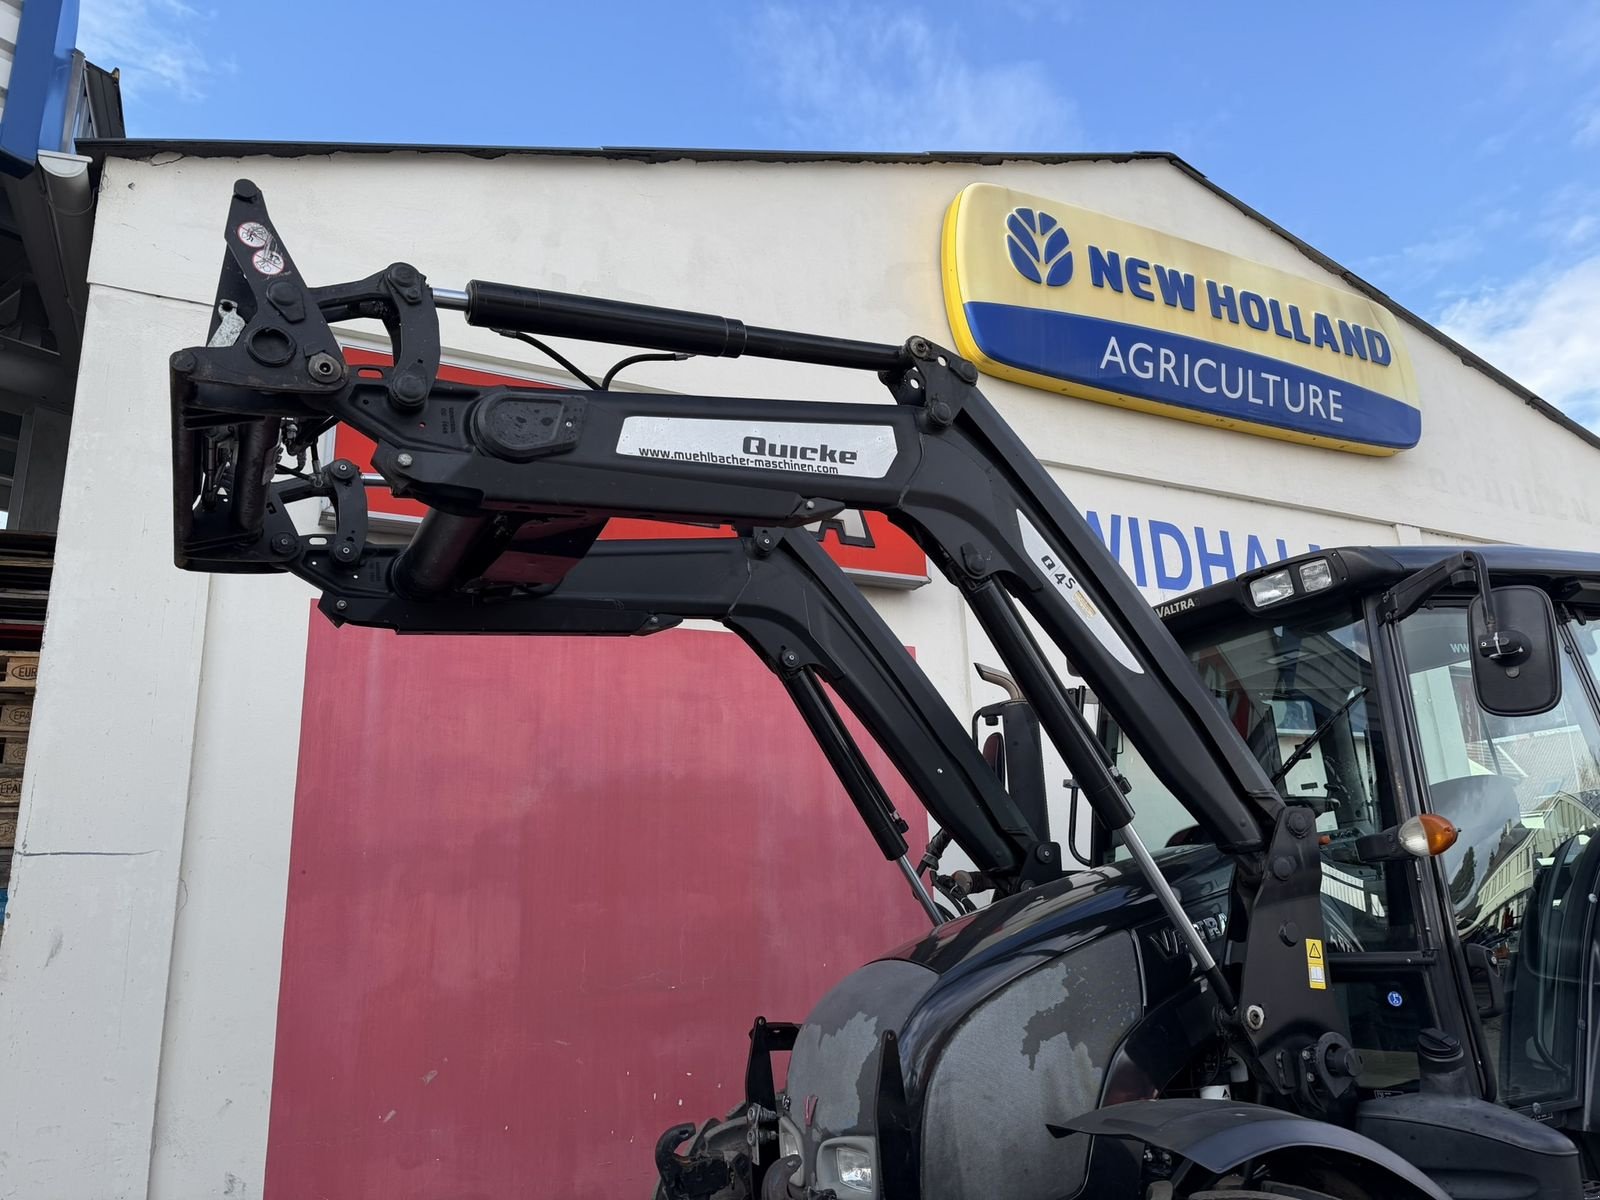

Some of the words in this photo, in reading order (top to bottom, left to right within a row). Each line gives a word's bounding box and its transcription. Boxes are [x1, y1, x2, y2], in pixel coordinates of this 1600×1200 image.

[1087, 244, 1195, 312] NEW
[1205, 279, 1392, 367] HOLLAND
[1099, 336, 1344, 423] AGRICULTURE
[638, 447, 839, 475] www.muehlbacher-maschinen.com
[742, 436, 858, 465] Quicke
[1155, 597, 1195, 618] VALTRA
[13, 711, 32, 721] EPA
